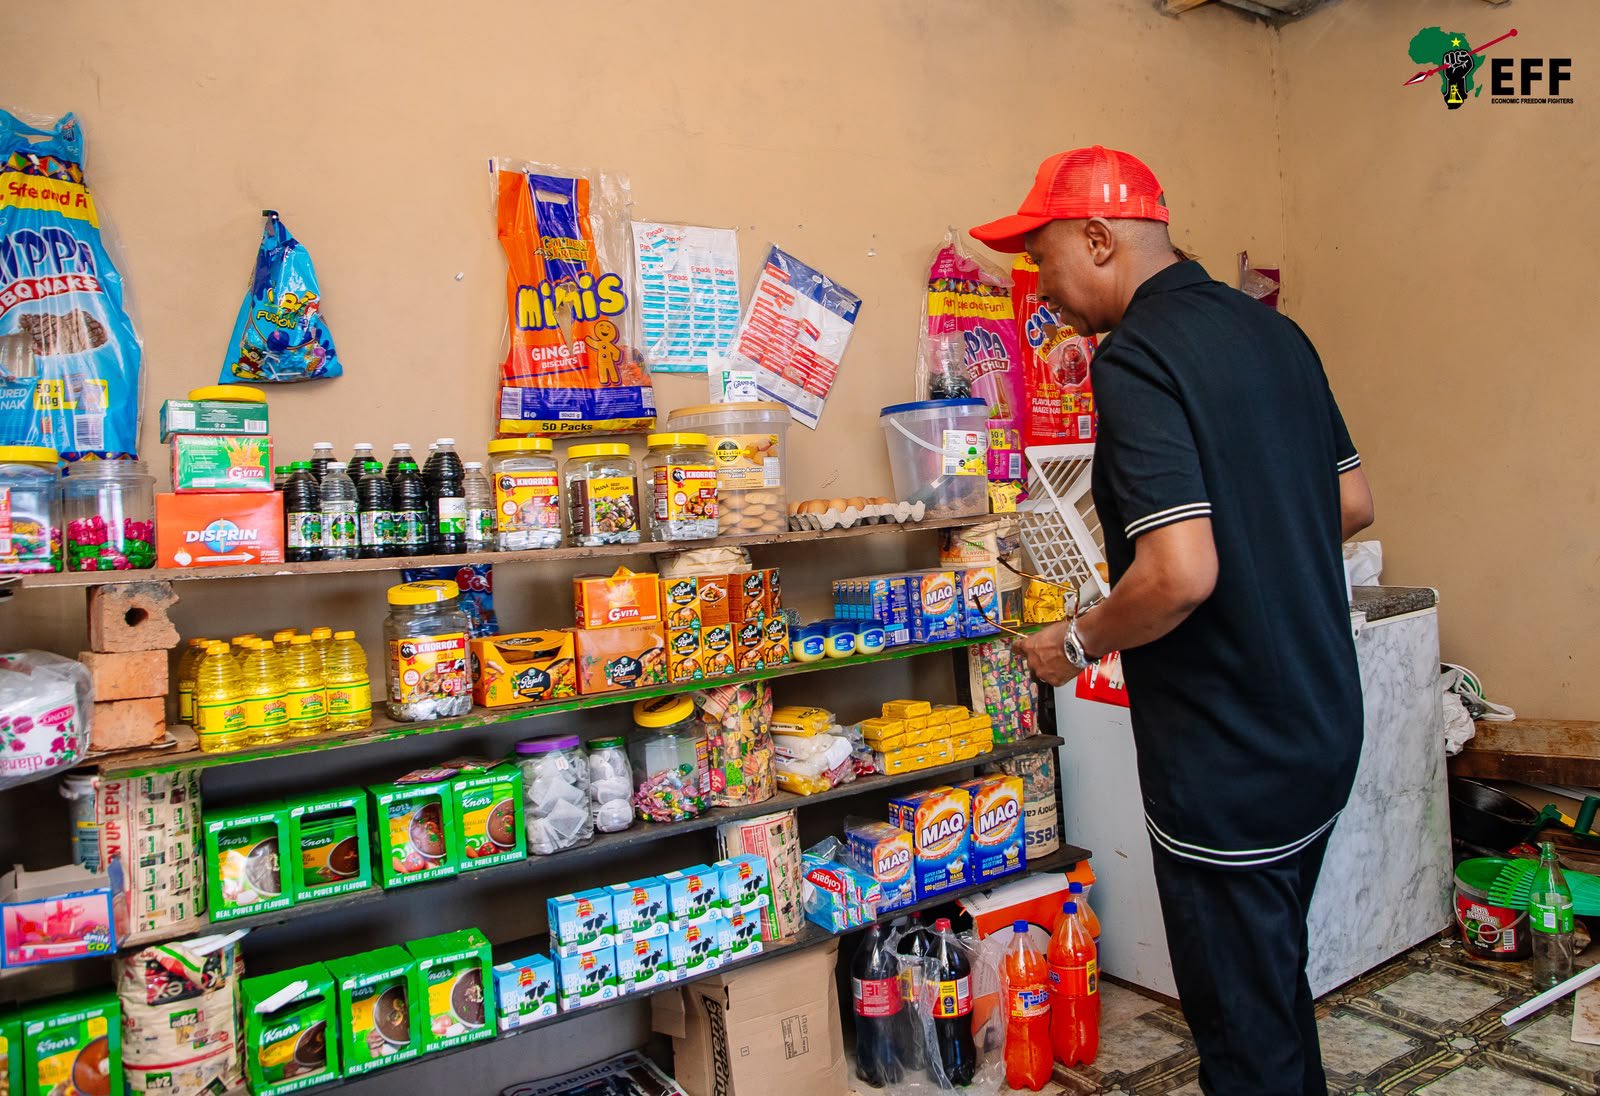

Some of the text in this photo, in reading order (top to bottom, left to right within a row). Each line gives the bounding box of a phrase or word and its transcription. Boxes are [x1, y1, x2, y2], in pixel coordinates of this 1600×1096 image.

[667, 273, 688, 281] Panado
[984, 302, 1005, 312] Fun!
[256, 310, 297, 330] FUSION
[542, 422, 593, 432] 50 Packs
[516, 477, 555, 486] KNORROX
[685, 470, 717, 479] KNORROX
[185, 528, 259, 544] DISPRIN
[926, 585, 954, 605] MAQ
[967, 580, 994, 601] MAQ
[417, 639, 459, 652] KNORROX
[389, 802, 411, 814] norr
[462, 796, 492, 808] Knorr
[979, 799, 1019, 835] MAQ
[105, 821, 121, 841] UP
[922, 812, 965, 849] MAQ
[460, 861, 474, 869] REAL
[474, 858, 492, 867] POWER
[500, 851, 523, 861] FLAVOUR
[878, 850, 909, 874] MAQ
[982, 859, 1003, 869] BUSTING
[388, 866, 455, 886] REAL POWER OF FLAVOUR
[811, 871, 842, 892] Colgate
[924, 874, 946, 884] BUSTING
[297, 880, 367, 900] REAL POWER OF FLAVOUR
[215, 898, 290, 919] REAL POWER OF FLAVOUR
[87, 942, 110, 952] GO!
[352, 986, 375, 997] norr
[36, 1034, 76, 1052] Knorr
[264, 1023, 300, 1043] Knorr
[426, 1029, 492, 1052] REAL POWER OF FLAVOUR
[705, 1000, 727, 1096] Supreme
[349, 1065, 363, 1074] REAL
[364, 1059, 385, 1071] POWER
[393, 1049, 418, 1062] FLAVOUR
[260, 1073, 334, 1096] REAL POWER OF FLAVOUR
